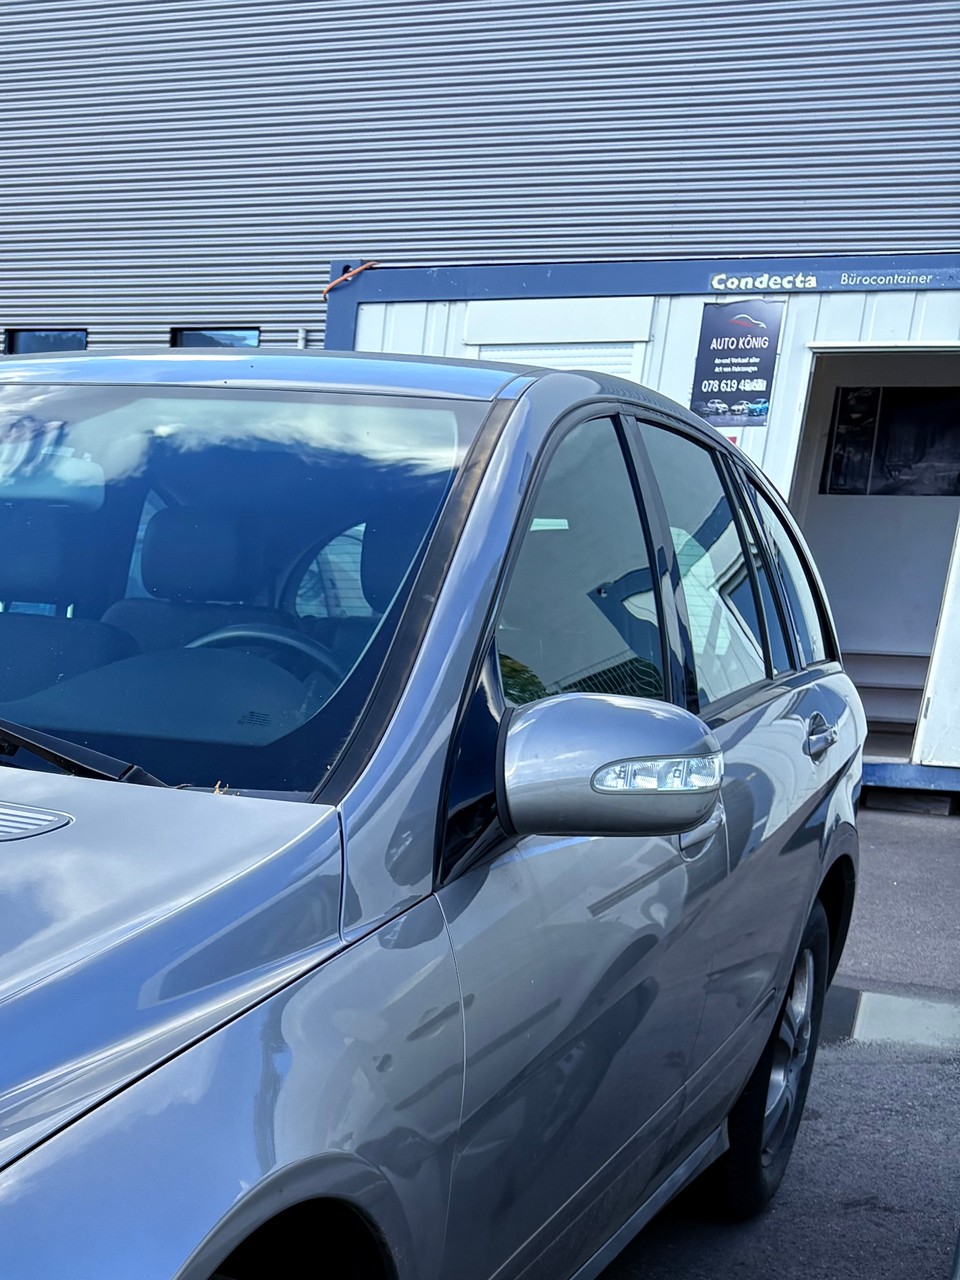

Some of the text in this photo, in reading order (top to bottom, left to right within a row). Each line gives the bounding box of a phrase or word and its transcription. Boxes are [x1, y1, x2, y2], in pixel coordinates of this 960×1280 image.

[711, 272, 933, 290] Condecta Bürocontainer
[710, 334, 769, 350] AUTO KÖNIG
[701, 380, 719, 393] 078
[720, 379, 738, 392] 619
